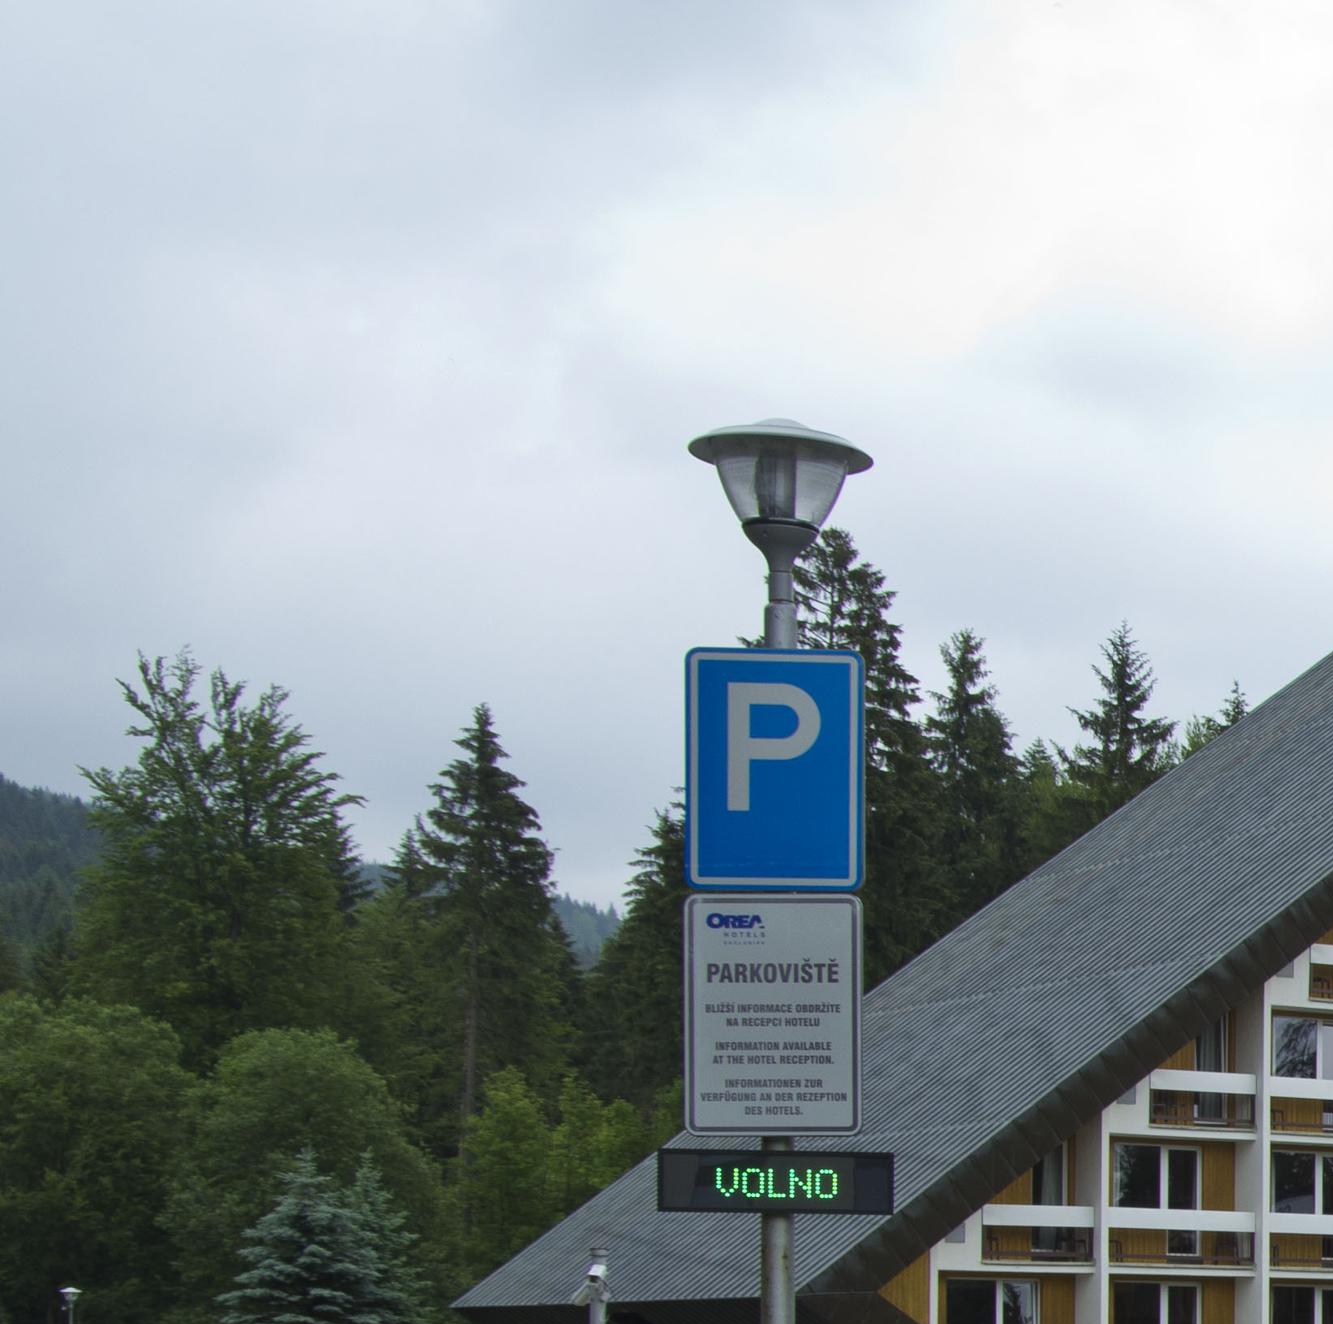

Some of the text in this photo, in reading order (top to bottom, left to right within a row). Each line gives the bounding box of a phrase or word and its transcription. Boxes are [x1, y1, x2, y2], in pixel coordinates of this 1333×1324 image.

[727, 682, 822, 811] P
[706, 913, 764, 929] OREA
[706, 958, 840, 984] PARKOVIŠTĚ
[705, 1001, 736, 1013] BLIŽŠÍ
[737, 1003, 793, 1013] INFORMACE
[726, 1018, 821, 1027] NA RECEPCI HOTELU
[715, 1041, 832, 1051] INFORMATION AVAILABLE
[712, 1055, 835, 1065] AT THE HOTEL RECEPTION.
[725, 1079, 823, 1088] INFORMATIONEN ZUR
[700, 1091, 848, 1102] VERFÜGUNG AN DER REZEPTION
[744, 1106, 803, 1116] DES HOTELS.
[716, 1167, 838, 1199] VOLNO
